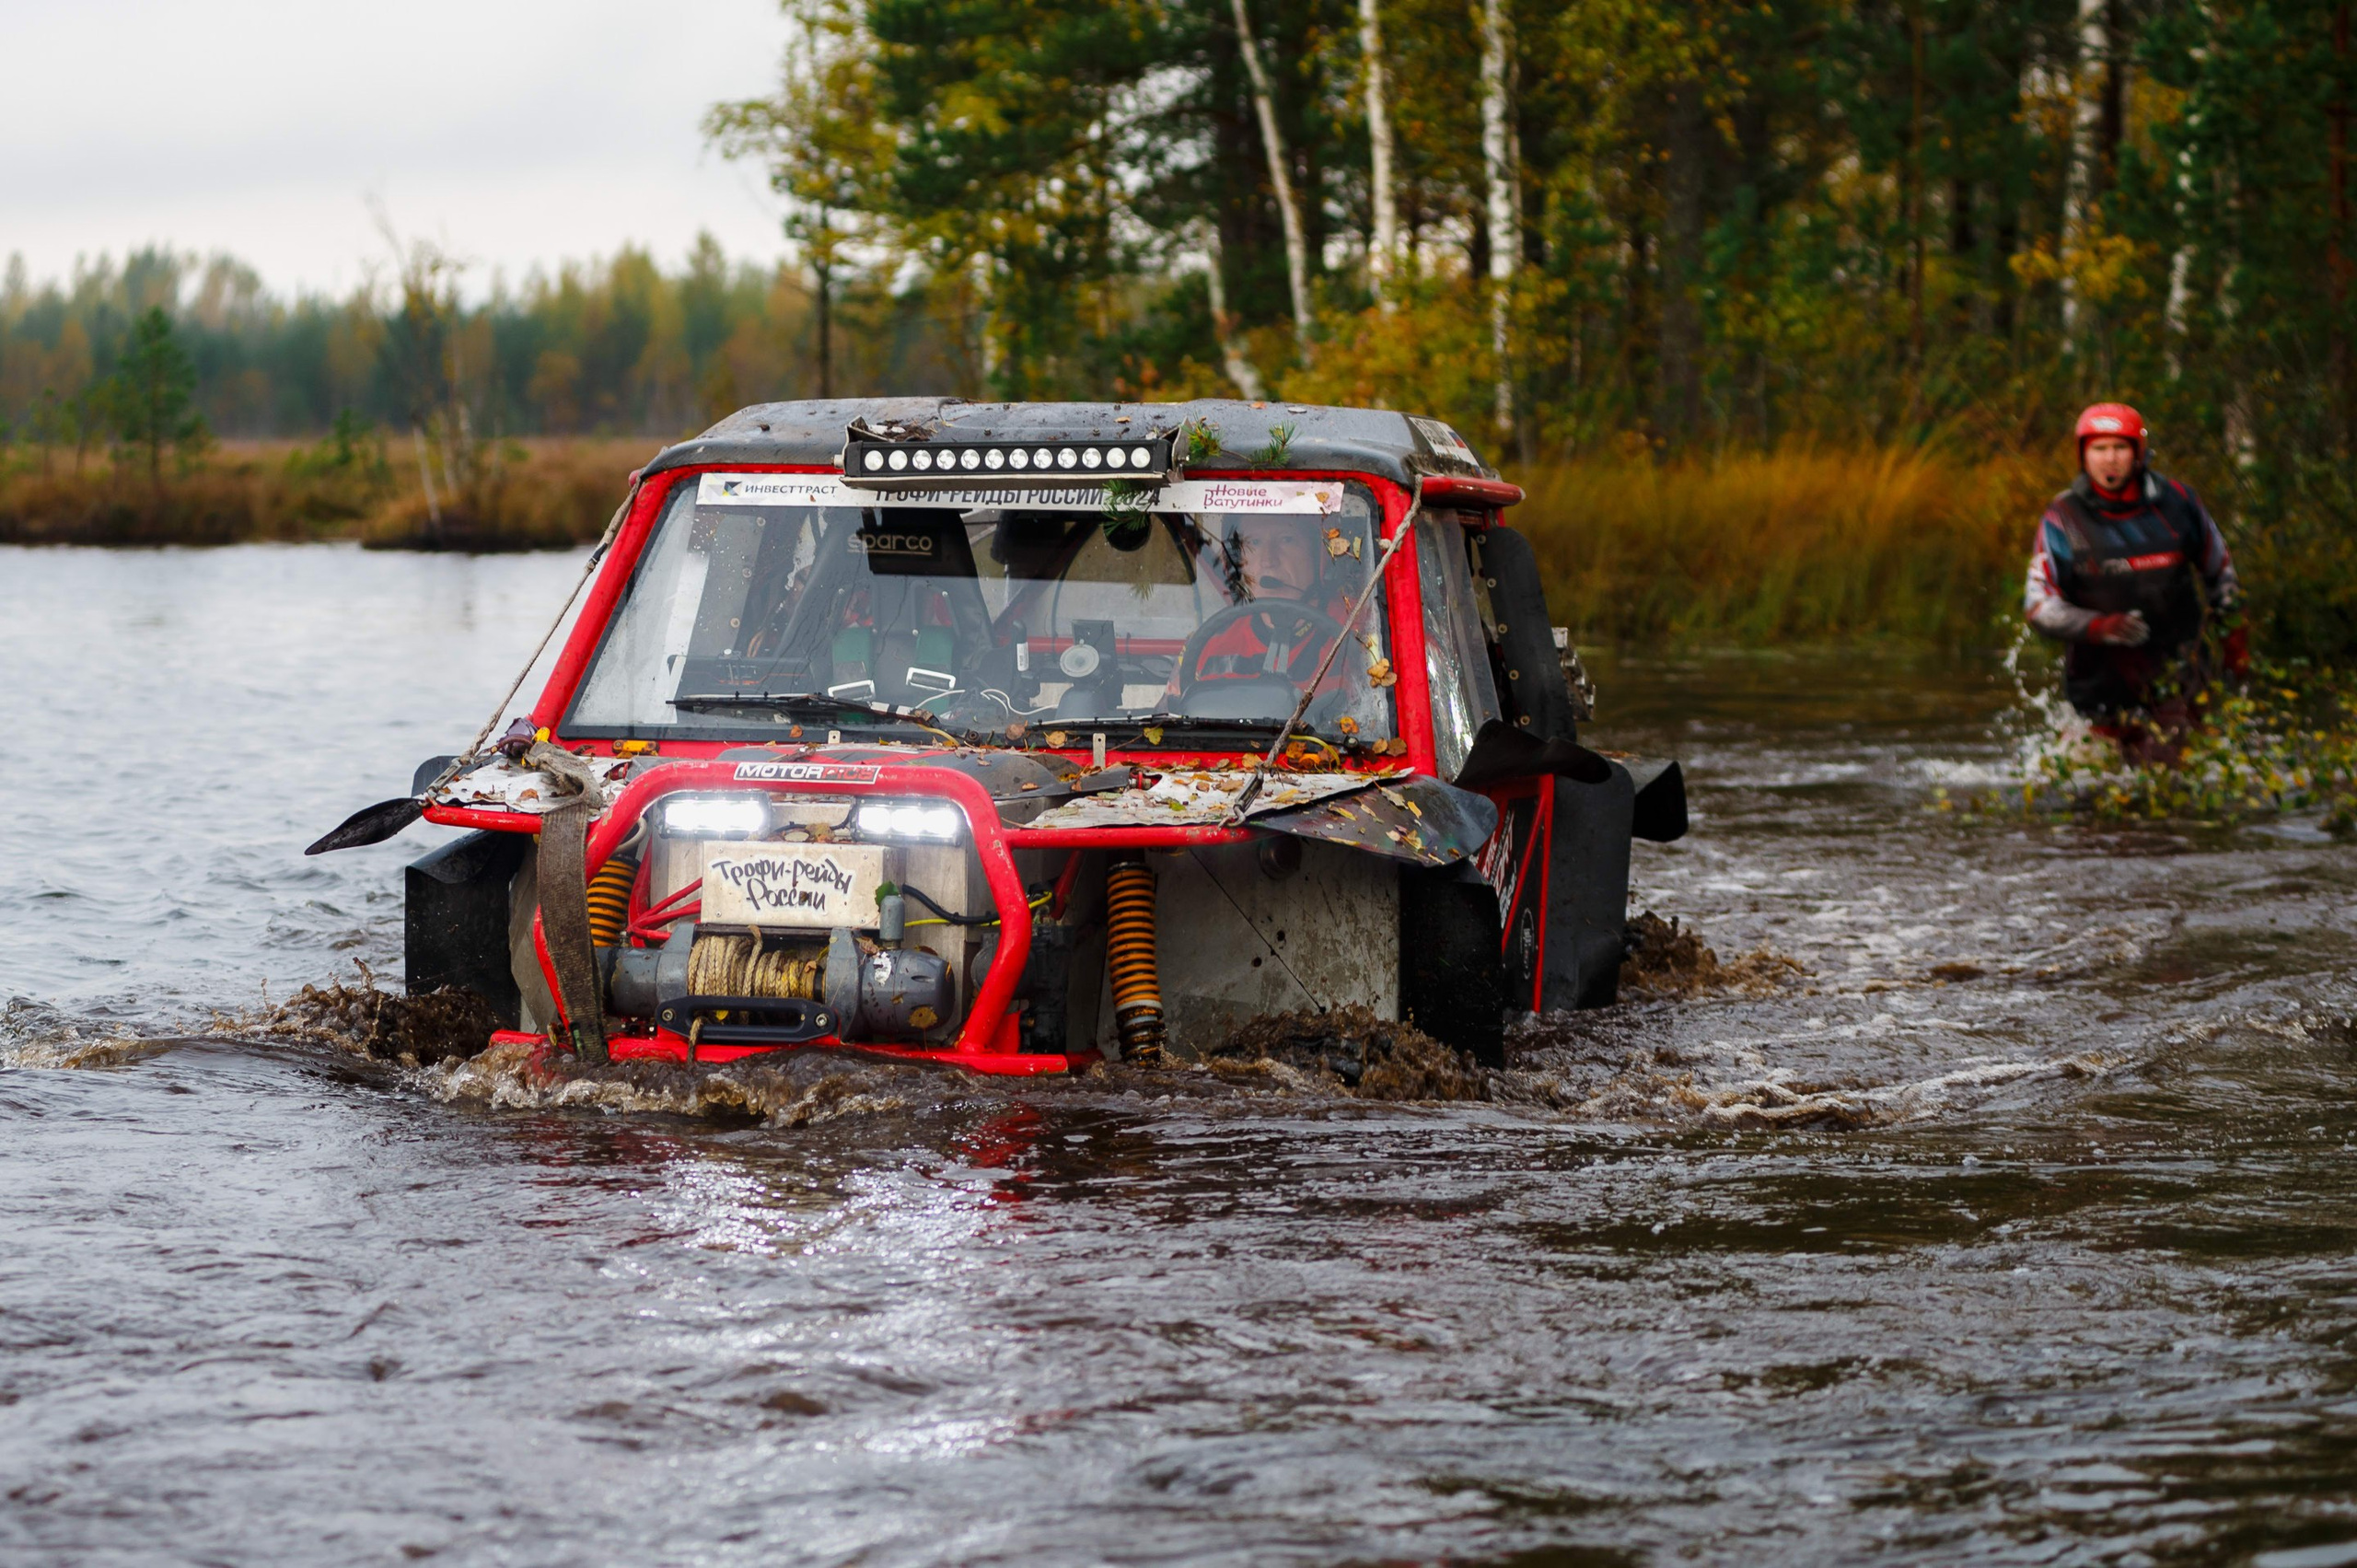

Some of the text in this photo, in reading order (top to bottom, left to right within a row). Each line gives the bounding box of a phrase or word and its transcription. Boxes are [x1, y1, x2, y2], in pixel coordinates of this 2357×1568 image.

[744, 484, 838, 494] ИНВЕСТТРАСТ
[1026, 488, 1104, 505] РОССИИ
[1204, 484, 1268, 497] Новые
[1203, 491, 1283, 509] Ватутинки
[847, 533, 933, 554] sparco
[712, 857, 853, 894] Трофи-рейды
[746, 877, 826, 912] России
